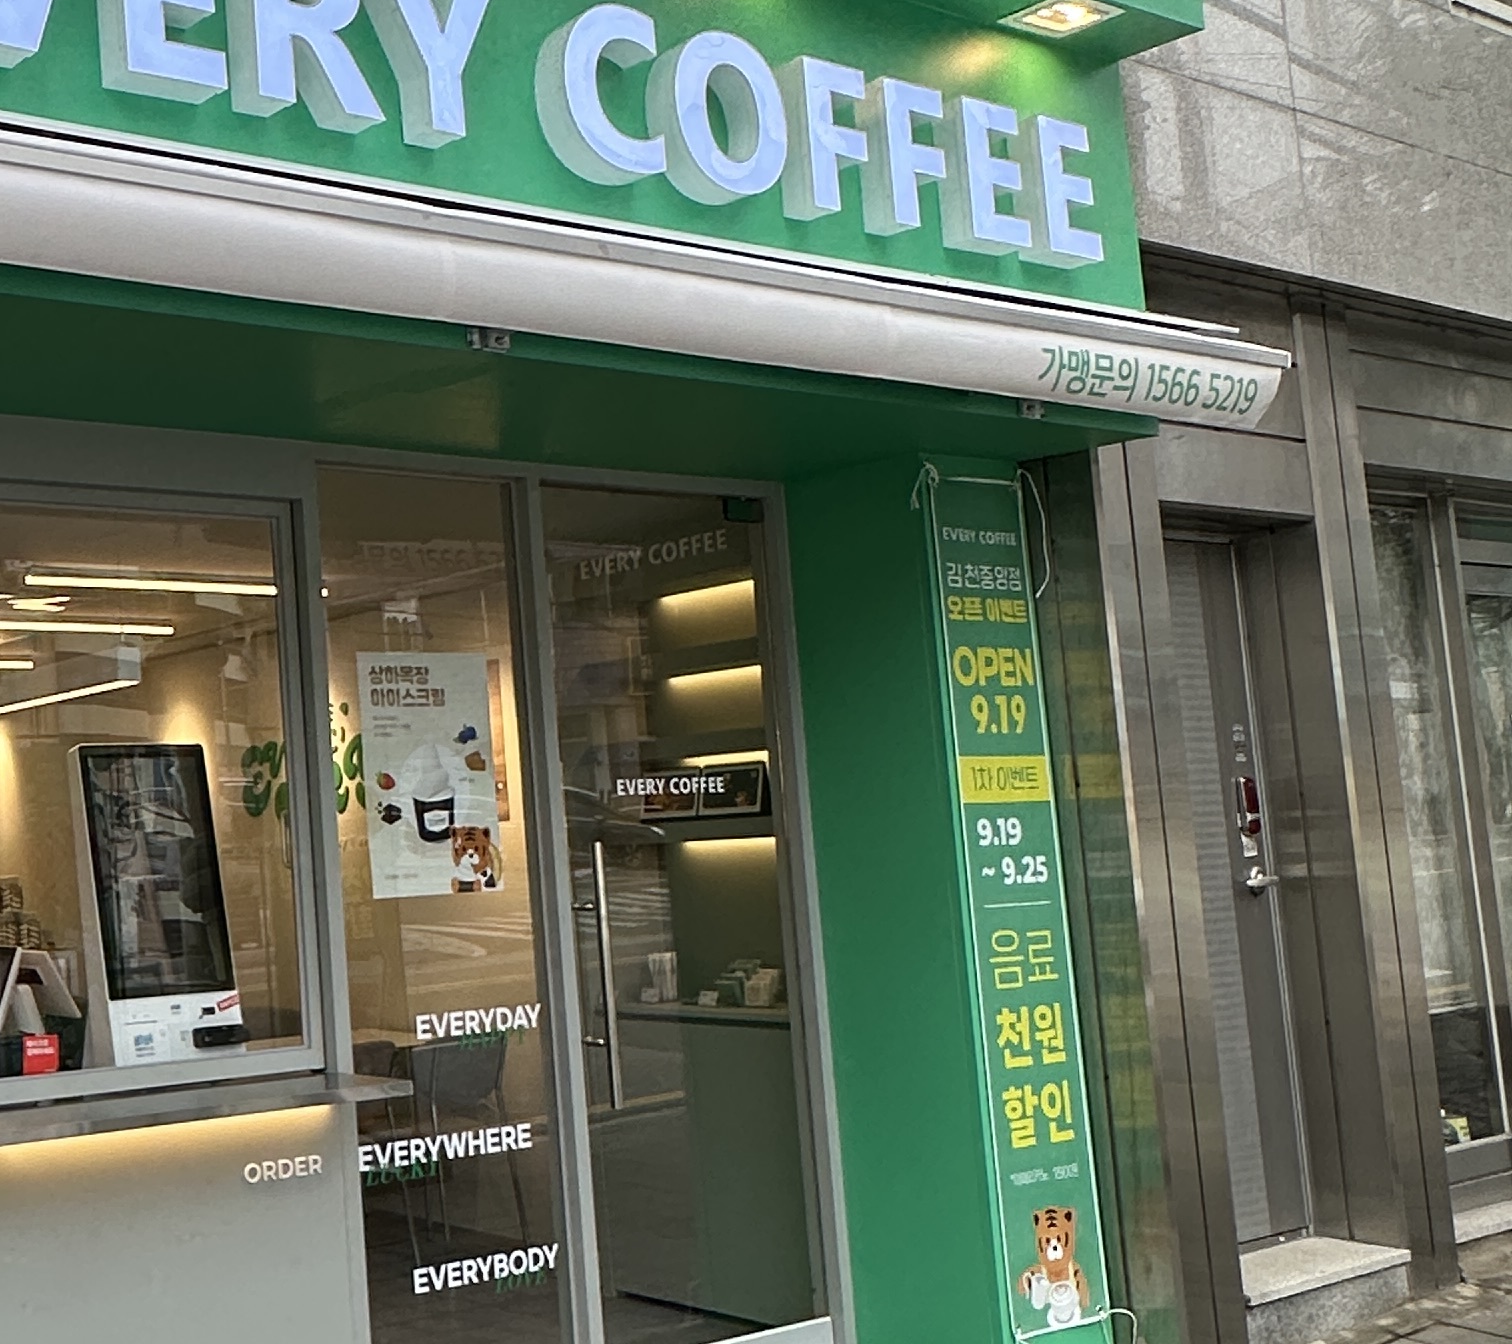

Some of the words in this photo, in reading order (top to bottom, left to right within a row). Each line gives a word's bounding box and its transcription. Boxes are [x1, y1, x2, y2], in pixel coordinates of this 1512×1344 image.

[534, 2, 1105, 270] COFFEE
[1038, 346, 1138, 404] 가맹문의
[1144, 362, 1201, 407] 1566
[1201, 372, 1259, 416] 5219
[580, 546, 642, 580] EVERY
[648, 528, 728, 565] COFFEE
[946, 562, 1022, 592] 김천중앙점
[947, 595, 984, 622] 오픈
[985, 597, 1028, 624] 이벤트
[368, 665, 431, 686] 상하목장
[953, 645, 1035, 686] OPEN
[370, 688, 446, 708] 아이스크림
[970, 694, 1026, 734] 9.19
[616, 778, 666, 796] EVERY
[669, 776, 726, 795] COFFEE
[971, 766, 993, 791] 1차
[996, 765, 1039, 791] 이벤트
[976, 817, 1022, 846] 9.19
[989, 929, 1060, 990] 음료
[415, 1003, 541, 1041] EVERYDAY
[996, 1002, 1067, 1069] 천원
[1002, 1079, 1076, 1149] 할인
[358, 1123, 533, 1173] EVERYWHERE
[244, 1154, 322, 1184] ORDER
[413, 1243, 559, 1295] EVERYBODY
